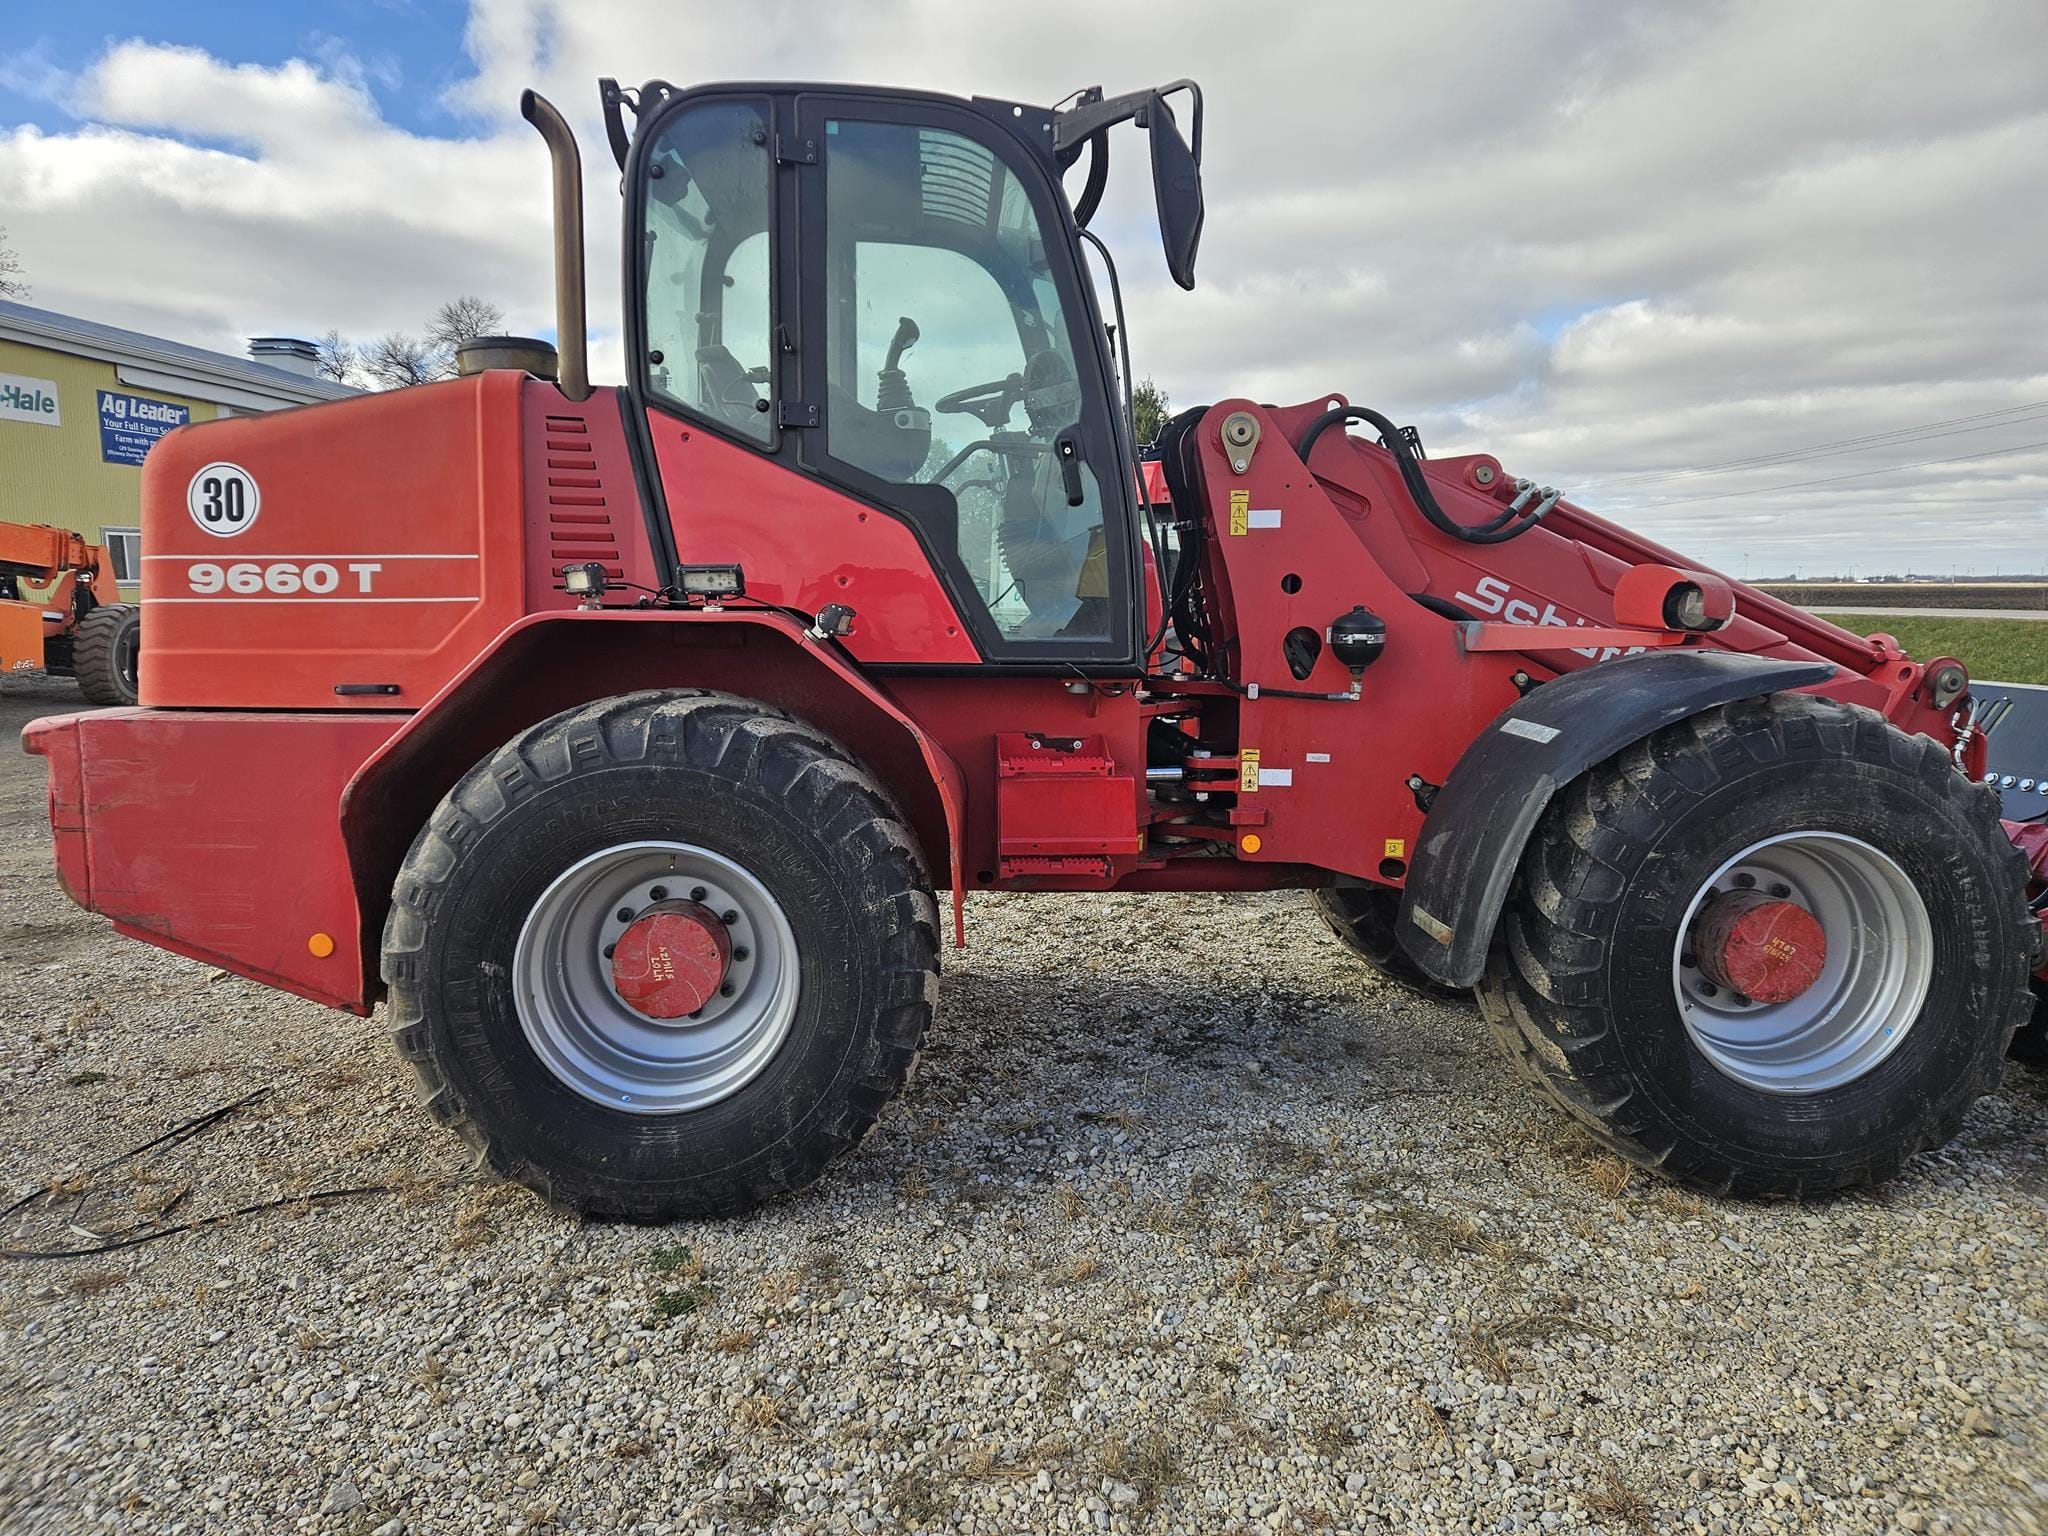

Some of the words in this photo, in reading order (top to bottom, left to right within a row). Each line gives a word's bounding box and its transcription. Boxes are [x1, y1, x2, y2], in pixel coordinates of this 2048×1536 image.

[101, 393, 126, 418] Ag
[103, 417, 122, 428] Your
[124, 421, 138, 430] Full
[140, 423, 159, 434] Farm
[115, 434, 132, 443] Farm
[133, 438, 149, 446] with
[203, 477, 244, 522] 30
[188, 563, 339, 594] 9660
[349, 563, 382, 593] T
[1772, 936, 1796, 956] 4707
[651, 957, 664, 981] 4707
